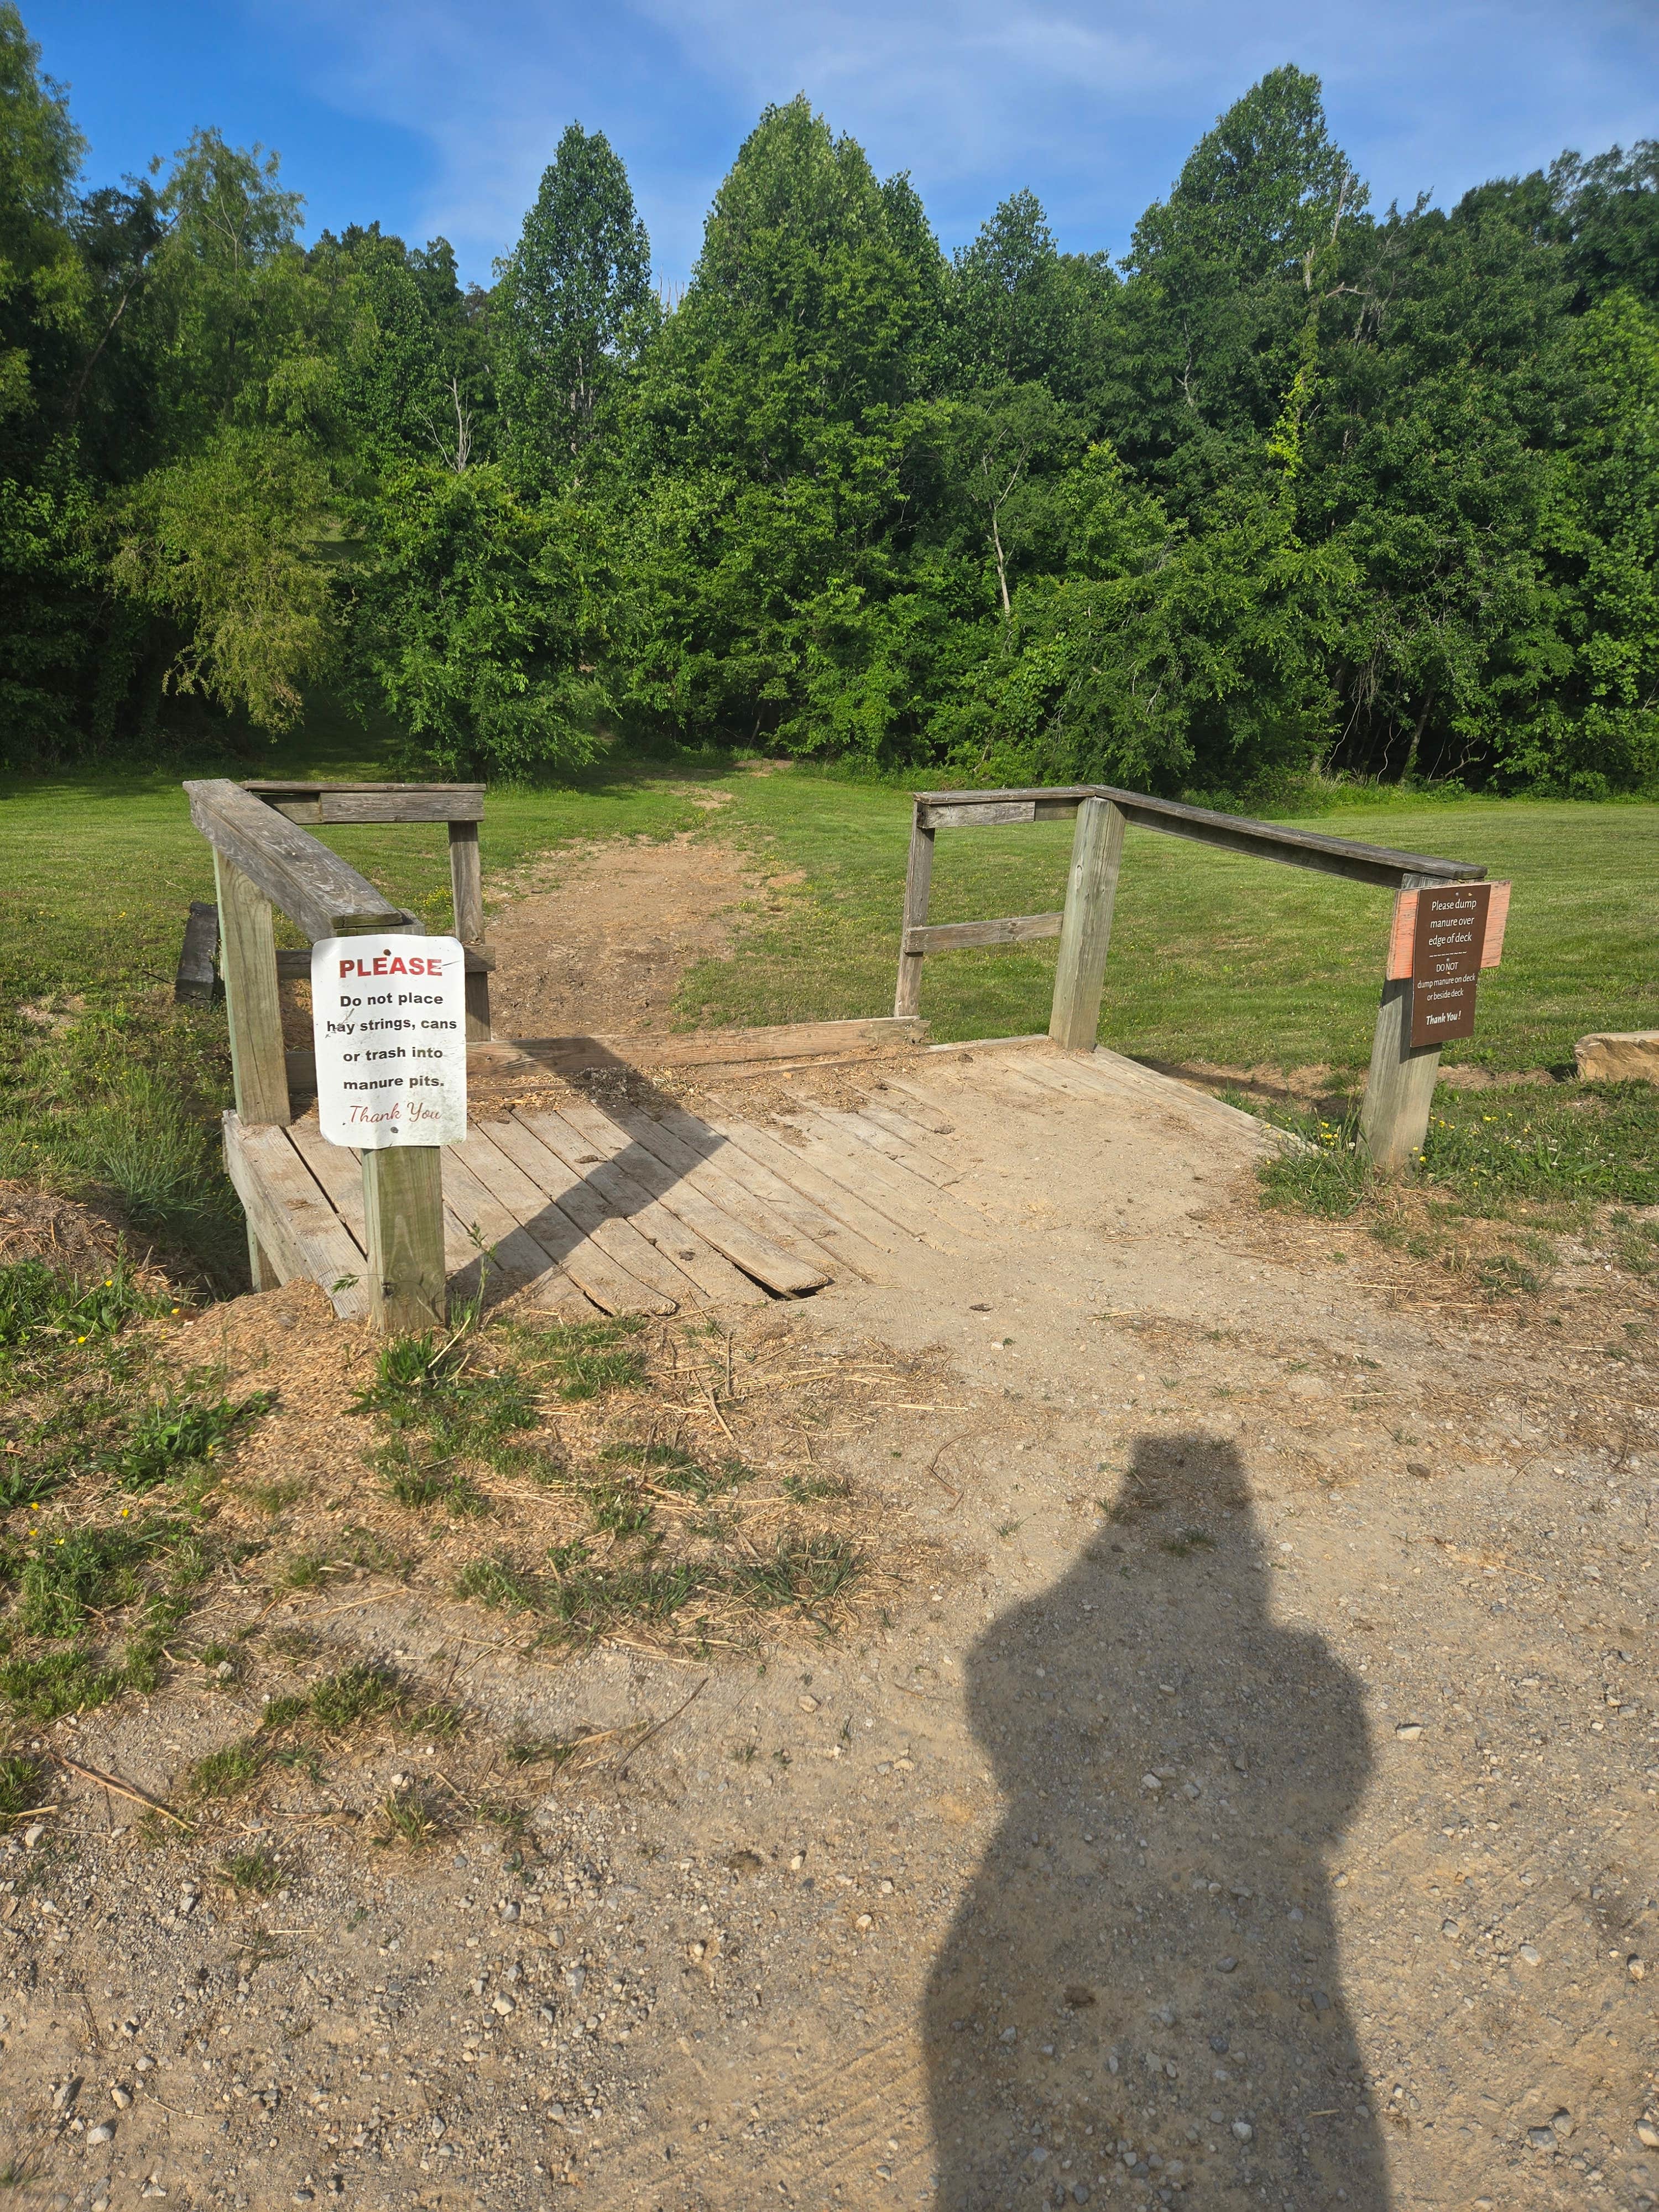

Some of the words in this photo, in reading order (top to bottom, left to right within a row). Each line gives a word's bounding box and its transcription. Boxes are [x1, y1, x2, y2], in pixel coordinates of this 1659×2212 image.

[1432, 900, 1454, 911] Please
[1455, 899, 1477, 910] dump
[1431, 919, 1457, 928] manure
[1459, 917, 1474, 926] over
[1429, 936, 1446, 948] edge
[1447, 933, 1455, 944] of
[1455, 932, 1472, 942] deck
[340, 957, 442, 978] PLEASE
[1447, 962, 1458, 971] NOT
[1417, 980, 1433, 989] dump
[1463, 973, 1475, 982] deck
[340, 995, 362, 1007] Do
[368, 993, 392, 1005] not
[399, 993, 443, 1005] place
[1433, 991, 1450, 1000] beside
[1451, 988, 1463, 997] deck
[1426, 1013, 1446, 1025] Thank
[1447, 1011, 1461, 1023] You!
[327, 1021, 354, 1035] hay
[360, 1019, 415, 1031] strings,
[421, 1019, 457, 1029] cans
[343, 1052, 359, 1061] or
[366, 1047, 405, 1061] trash
[412, 1047, 443, 1058] into
[343, 1076, 403, 1090] manure
[409, 1076, 444, 1088] pits.
[349, 1103, 401, 1123] Thank
[407, 1102, 441, 1121] You
